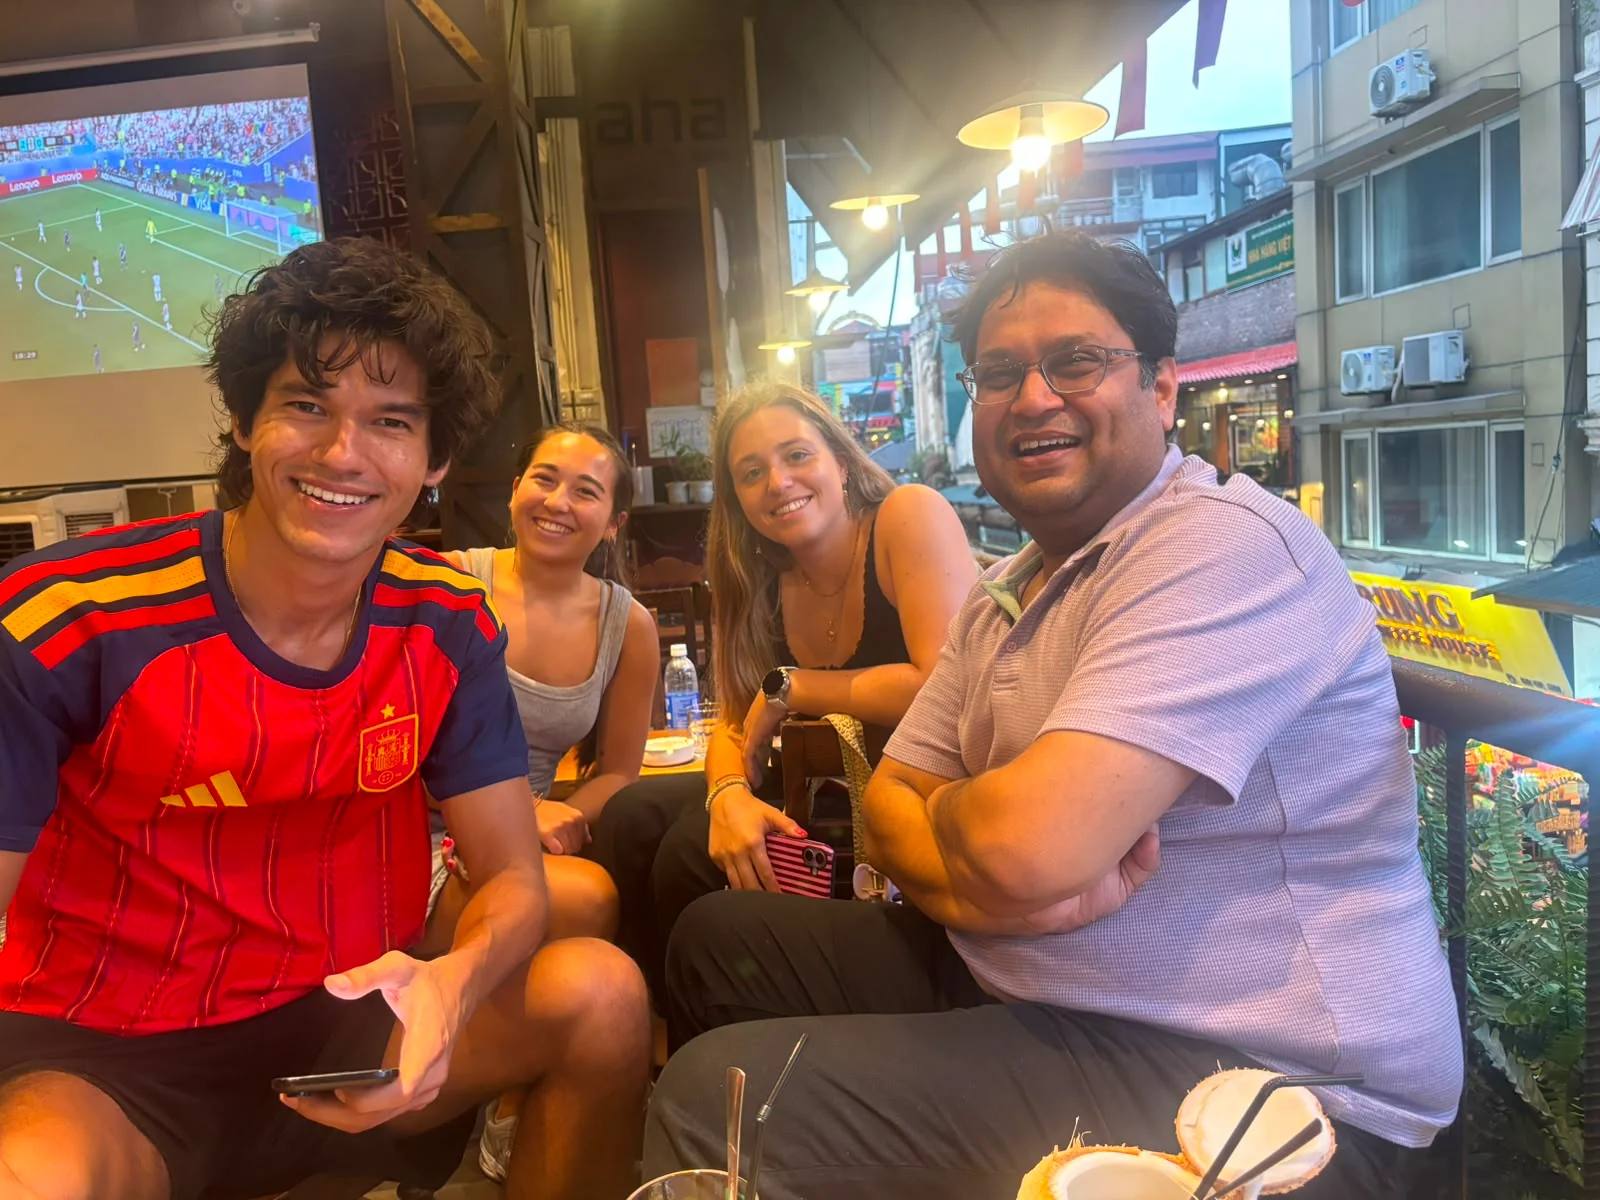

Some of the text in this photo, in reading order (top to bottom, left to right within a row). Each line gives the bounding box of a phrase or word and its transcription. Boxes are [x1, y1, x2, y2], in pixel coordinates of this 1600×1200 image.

[597, 91, 727, 144] aha
[9, 179, 40, 192] Lenovo
[52, 172, 83, 184] Lenovo
[194, 195, 212, 212] VISA
[1428, 630, 1502, 663] HOUSE
